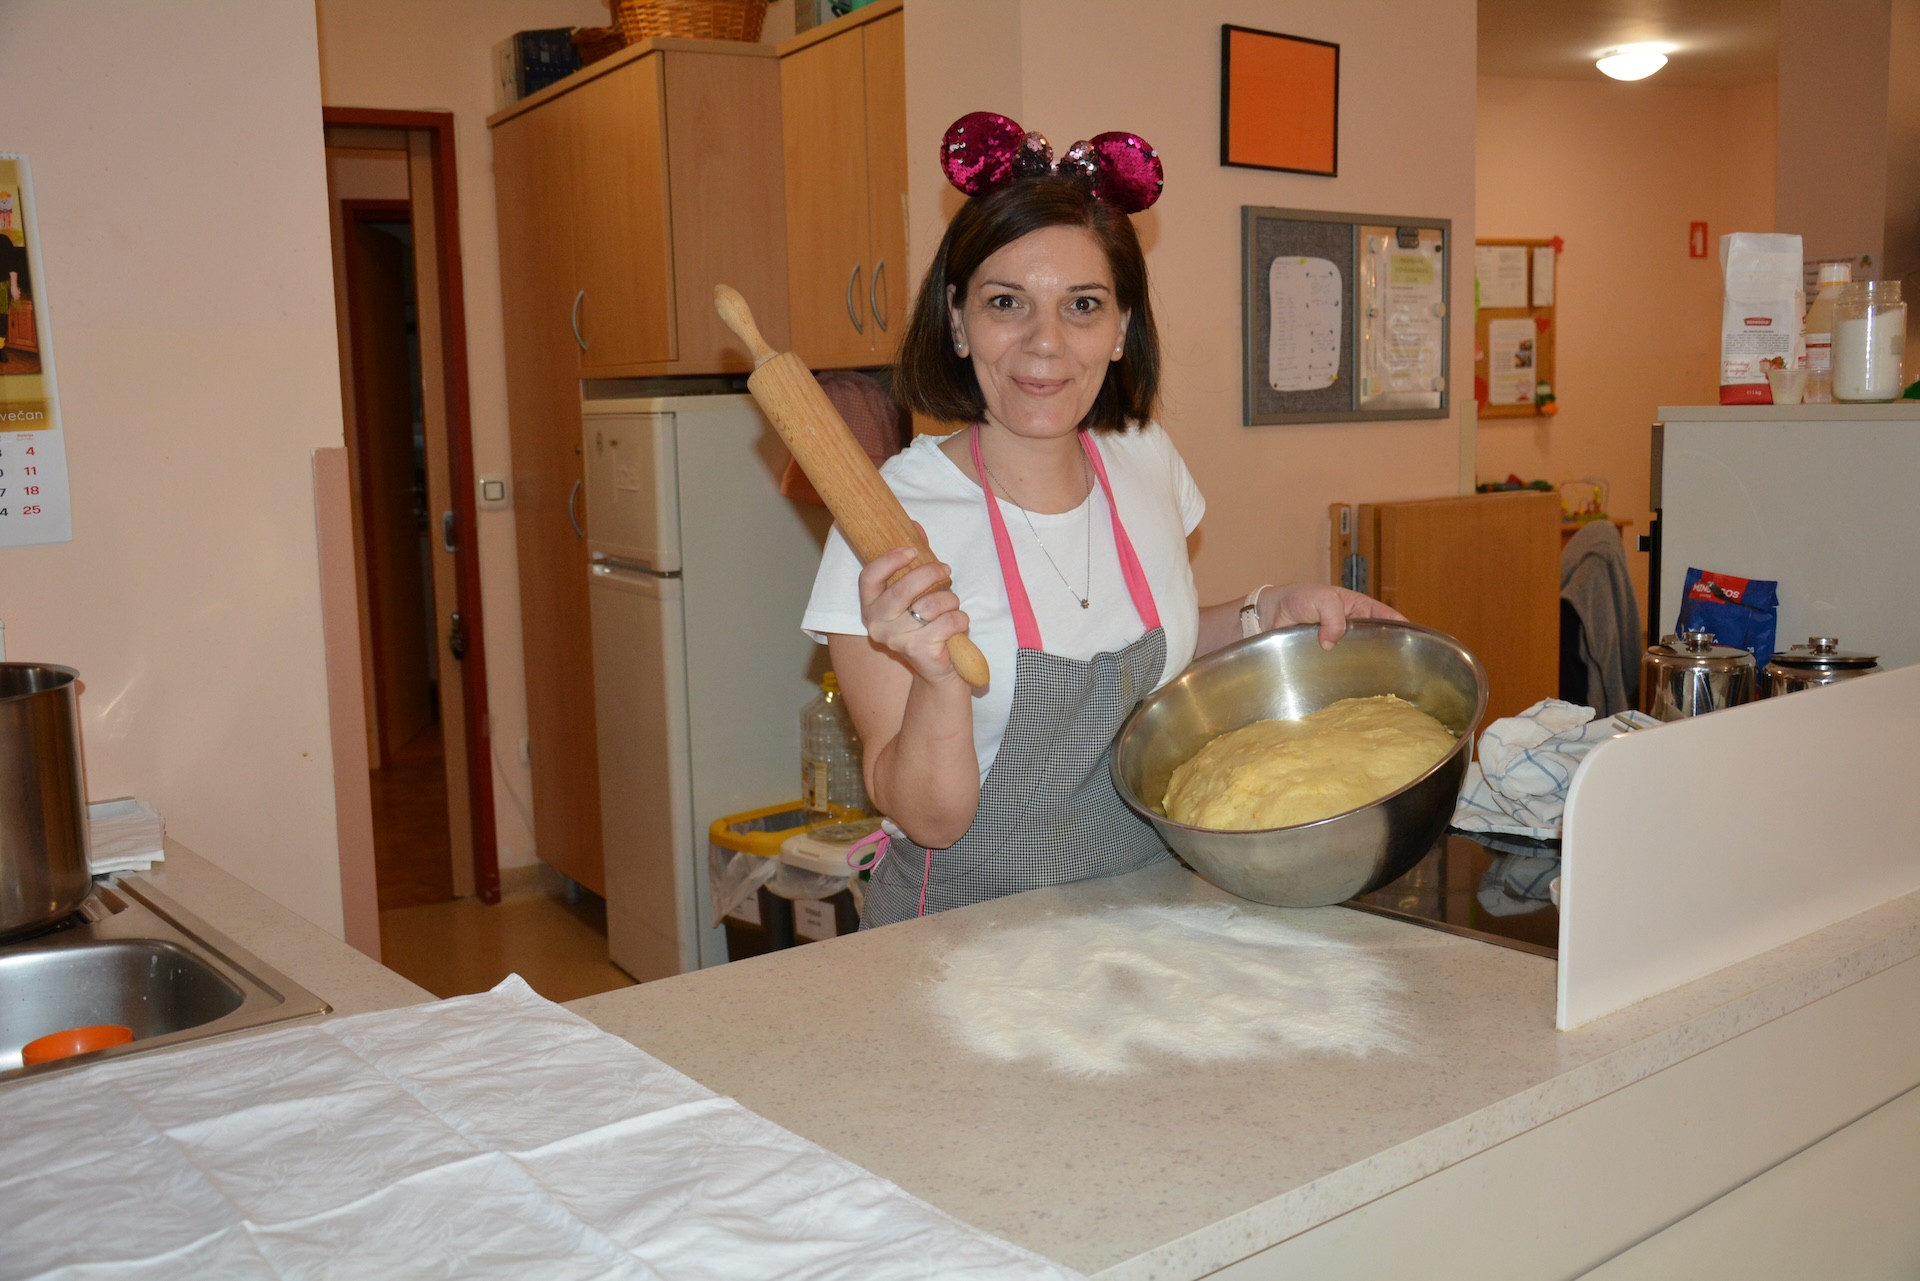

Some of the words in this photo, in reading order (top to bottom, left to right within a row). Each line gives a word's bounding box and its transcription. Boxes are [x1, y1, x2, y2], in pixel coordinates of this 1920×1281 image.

[26, 446, 35, 456] 4
[24, 466, 37, 476] 11
[24, 486, 40, 496] 18
[23, 505, 41, 515] 25
